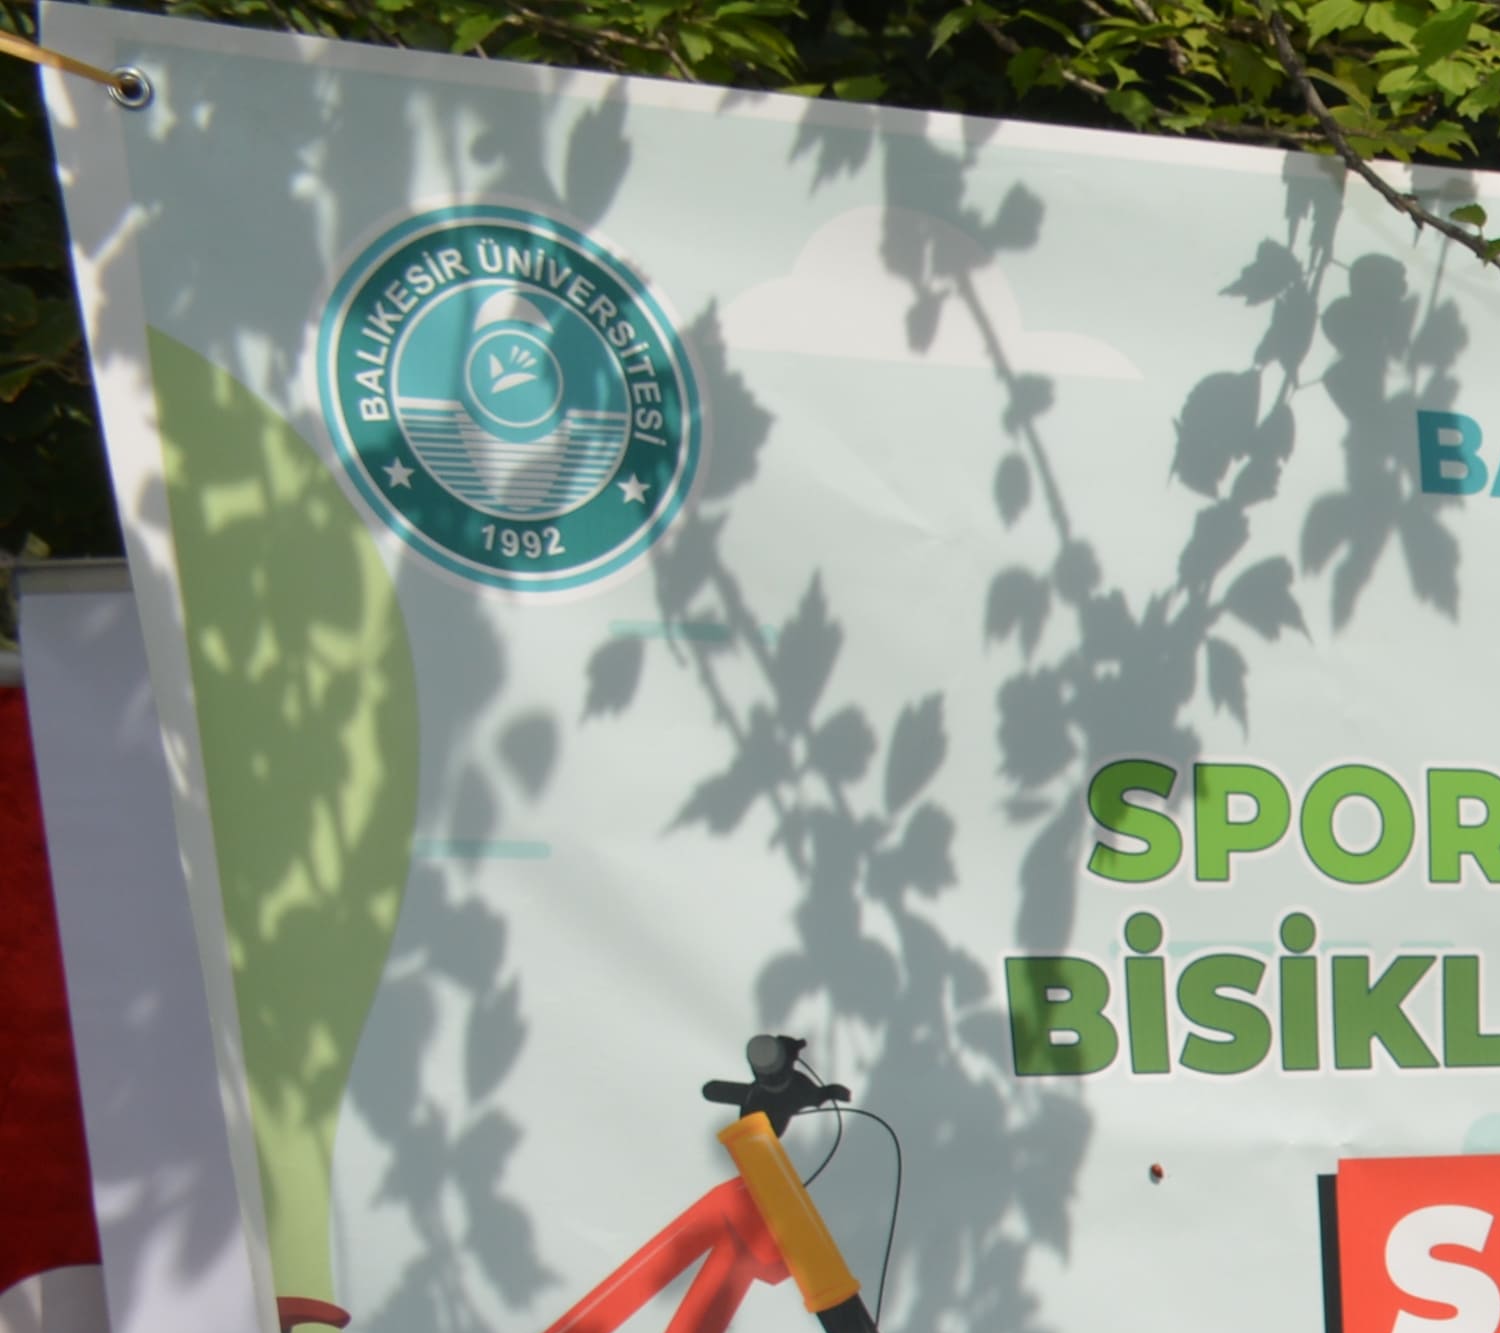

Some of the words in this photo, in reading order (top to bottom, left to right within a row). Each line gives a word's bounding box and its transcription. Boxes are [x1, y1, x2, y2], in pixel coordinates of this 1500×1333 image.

[355, 248, 471, 421] BALIKESİR
[477, 238, 667, 447] ÜNİVERSİTESİ
[481, 525, 565, 558] 1992
